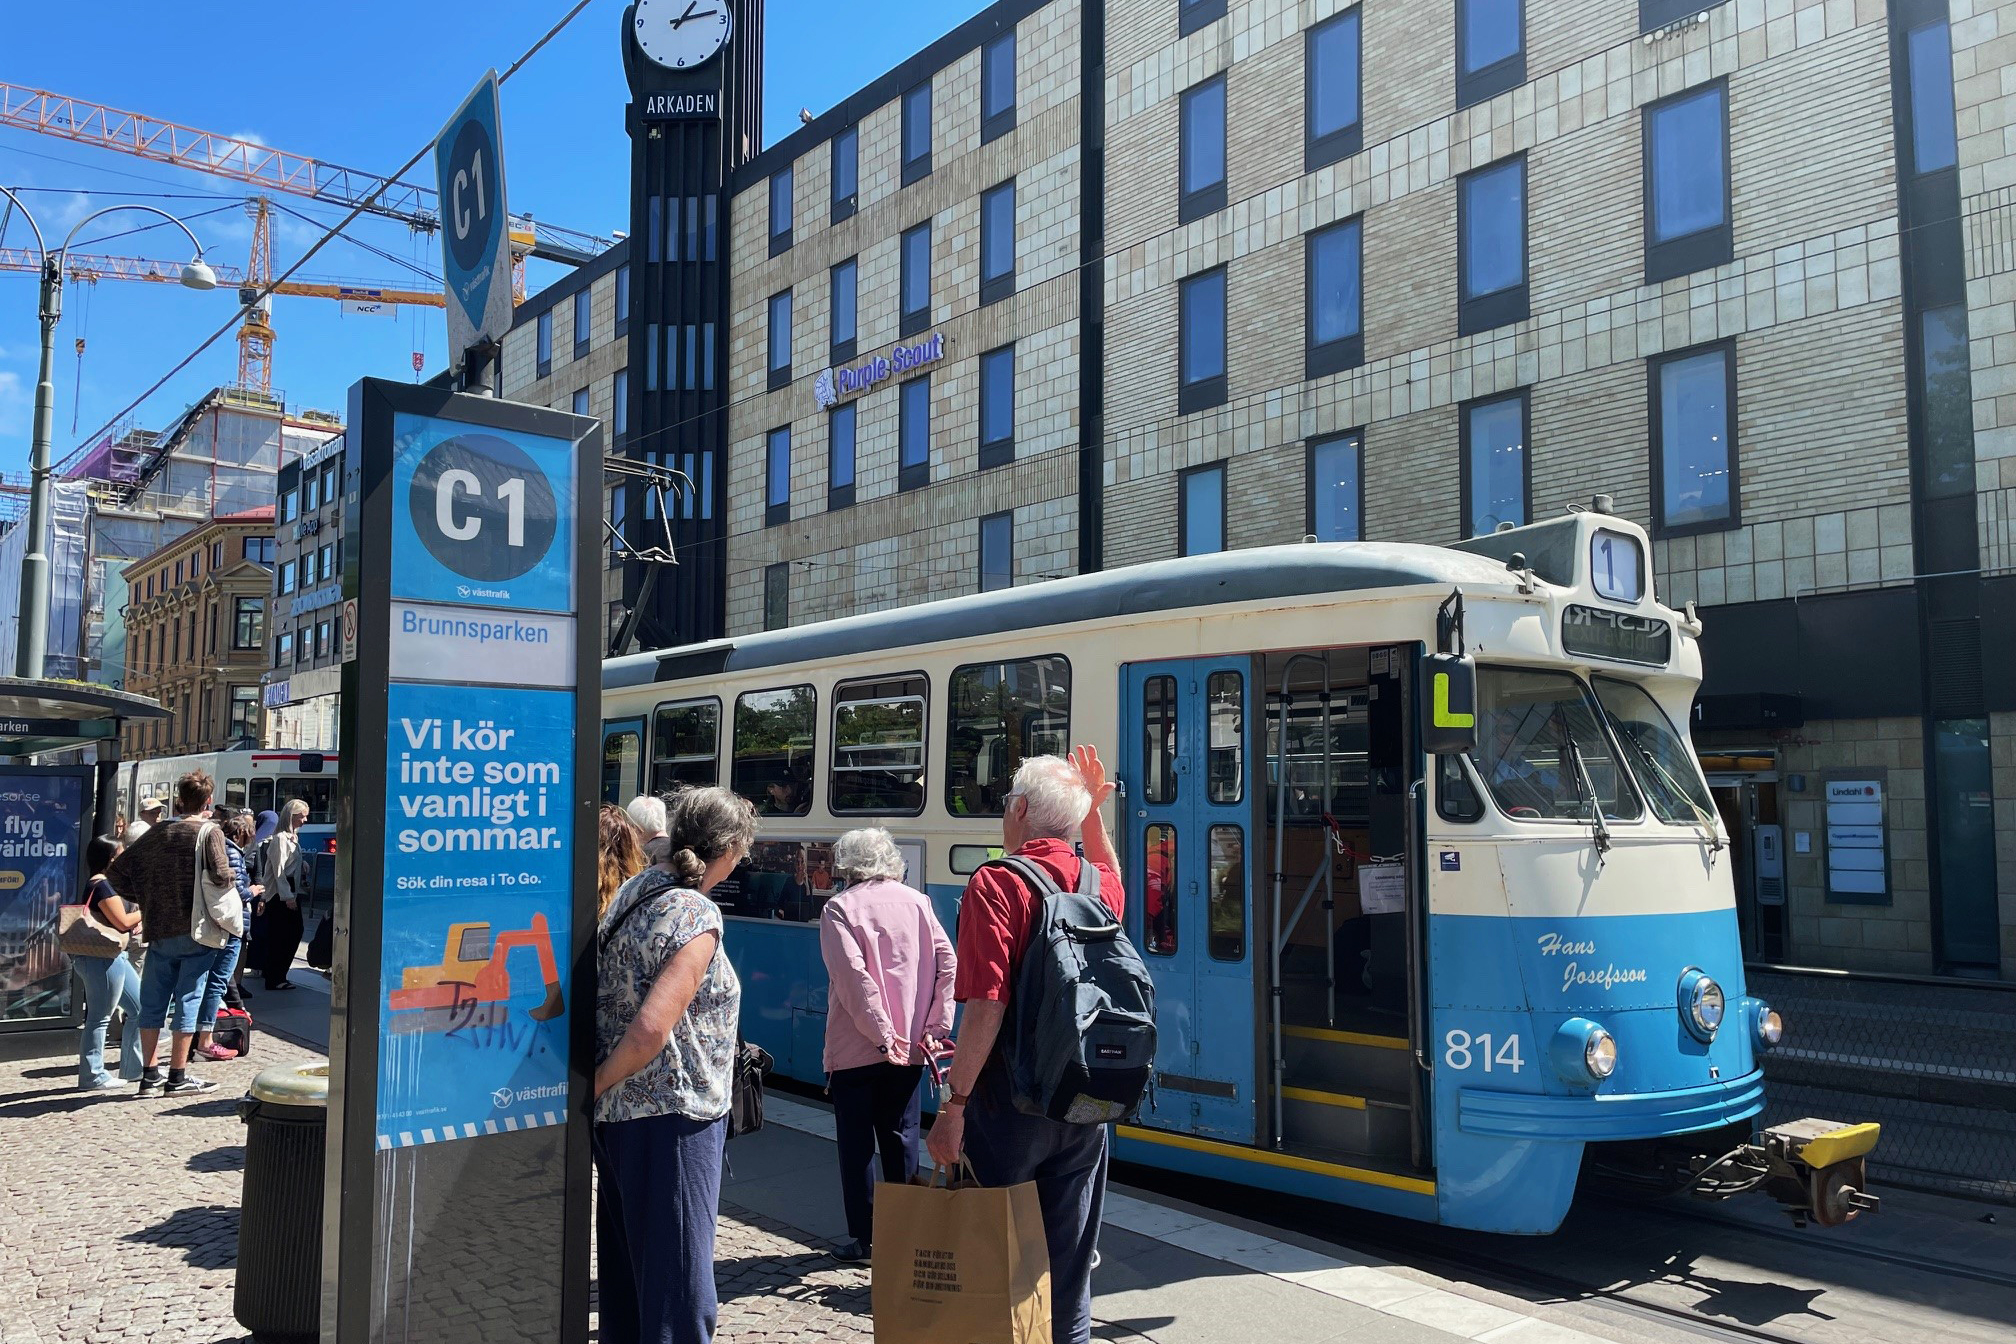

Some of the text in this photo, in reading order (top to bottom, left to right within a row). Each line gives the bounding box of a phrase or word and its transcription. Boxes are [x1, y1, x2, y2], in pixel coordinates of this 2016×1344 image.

[636, 18, 644, 28] 9
[719, 15, 727, 25] 3
[677, 57, 685, 67] 6
[646, 94, 714, 114] ARKADEN
[453, 148, 486, 240] C1
[839, 332, 944, 395] Purple Scout
[435, 469, 525, 548] C1
[1600, 538, 1615, 591] 1
[472, 588, 510, 600] västtrafik
[402, 610, 548, 644] Brunnsparken
[1433, 672, 1475, 728] L
[1694, 703, 1703, 721] 1
[401, 718, 515, 751] Vi kör
[401, 752, 560, 784] inte som
[0, 793, 40, 802] sor.se
[1832, 787, 1862, 796] Lindahl
[399, 786, 547, 825] vanligt i
[5, 815, 44, 839] flyg
[0, 839, 68, 858] ärlden
[398, 827, 562, 853] sommar.
[396, 876, 427, 890] Sök
[429, 875, 453, 889] din
[456, 876, 488, 887] resa
[498, 873, 516, 886] To
[518, 872, 542, 885] Go.
[1537, 932, 1597, 956] Hans
[1562, 962, 1648, 993] Josefsson
[1445, 1029, 1526, 1074] 814
